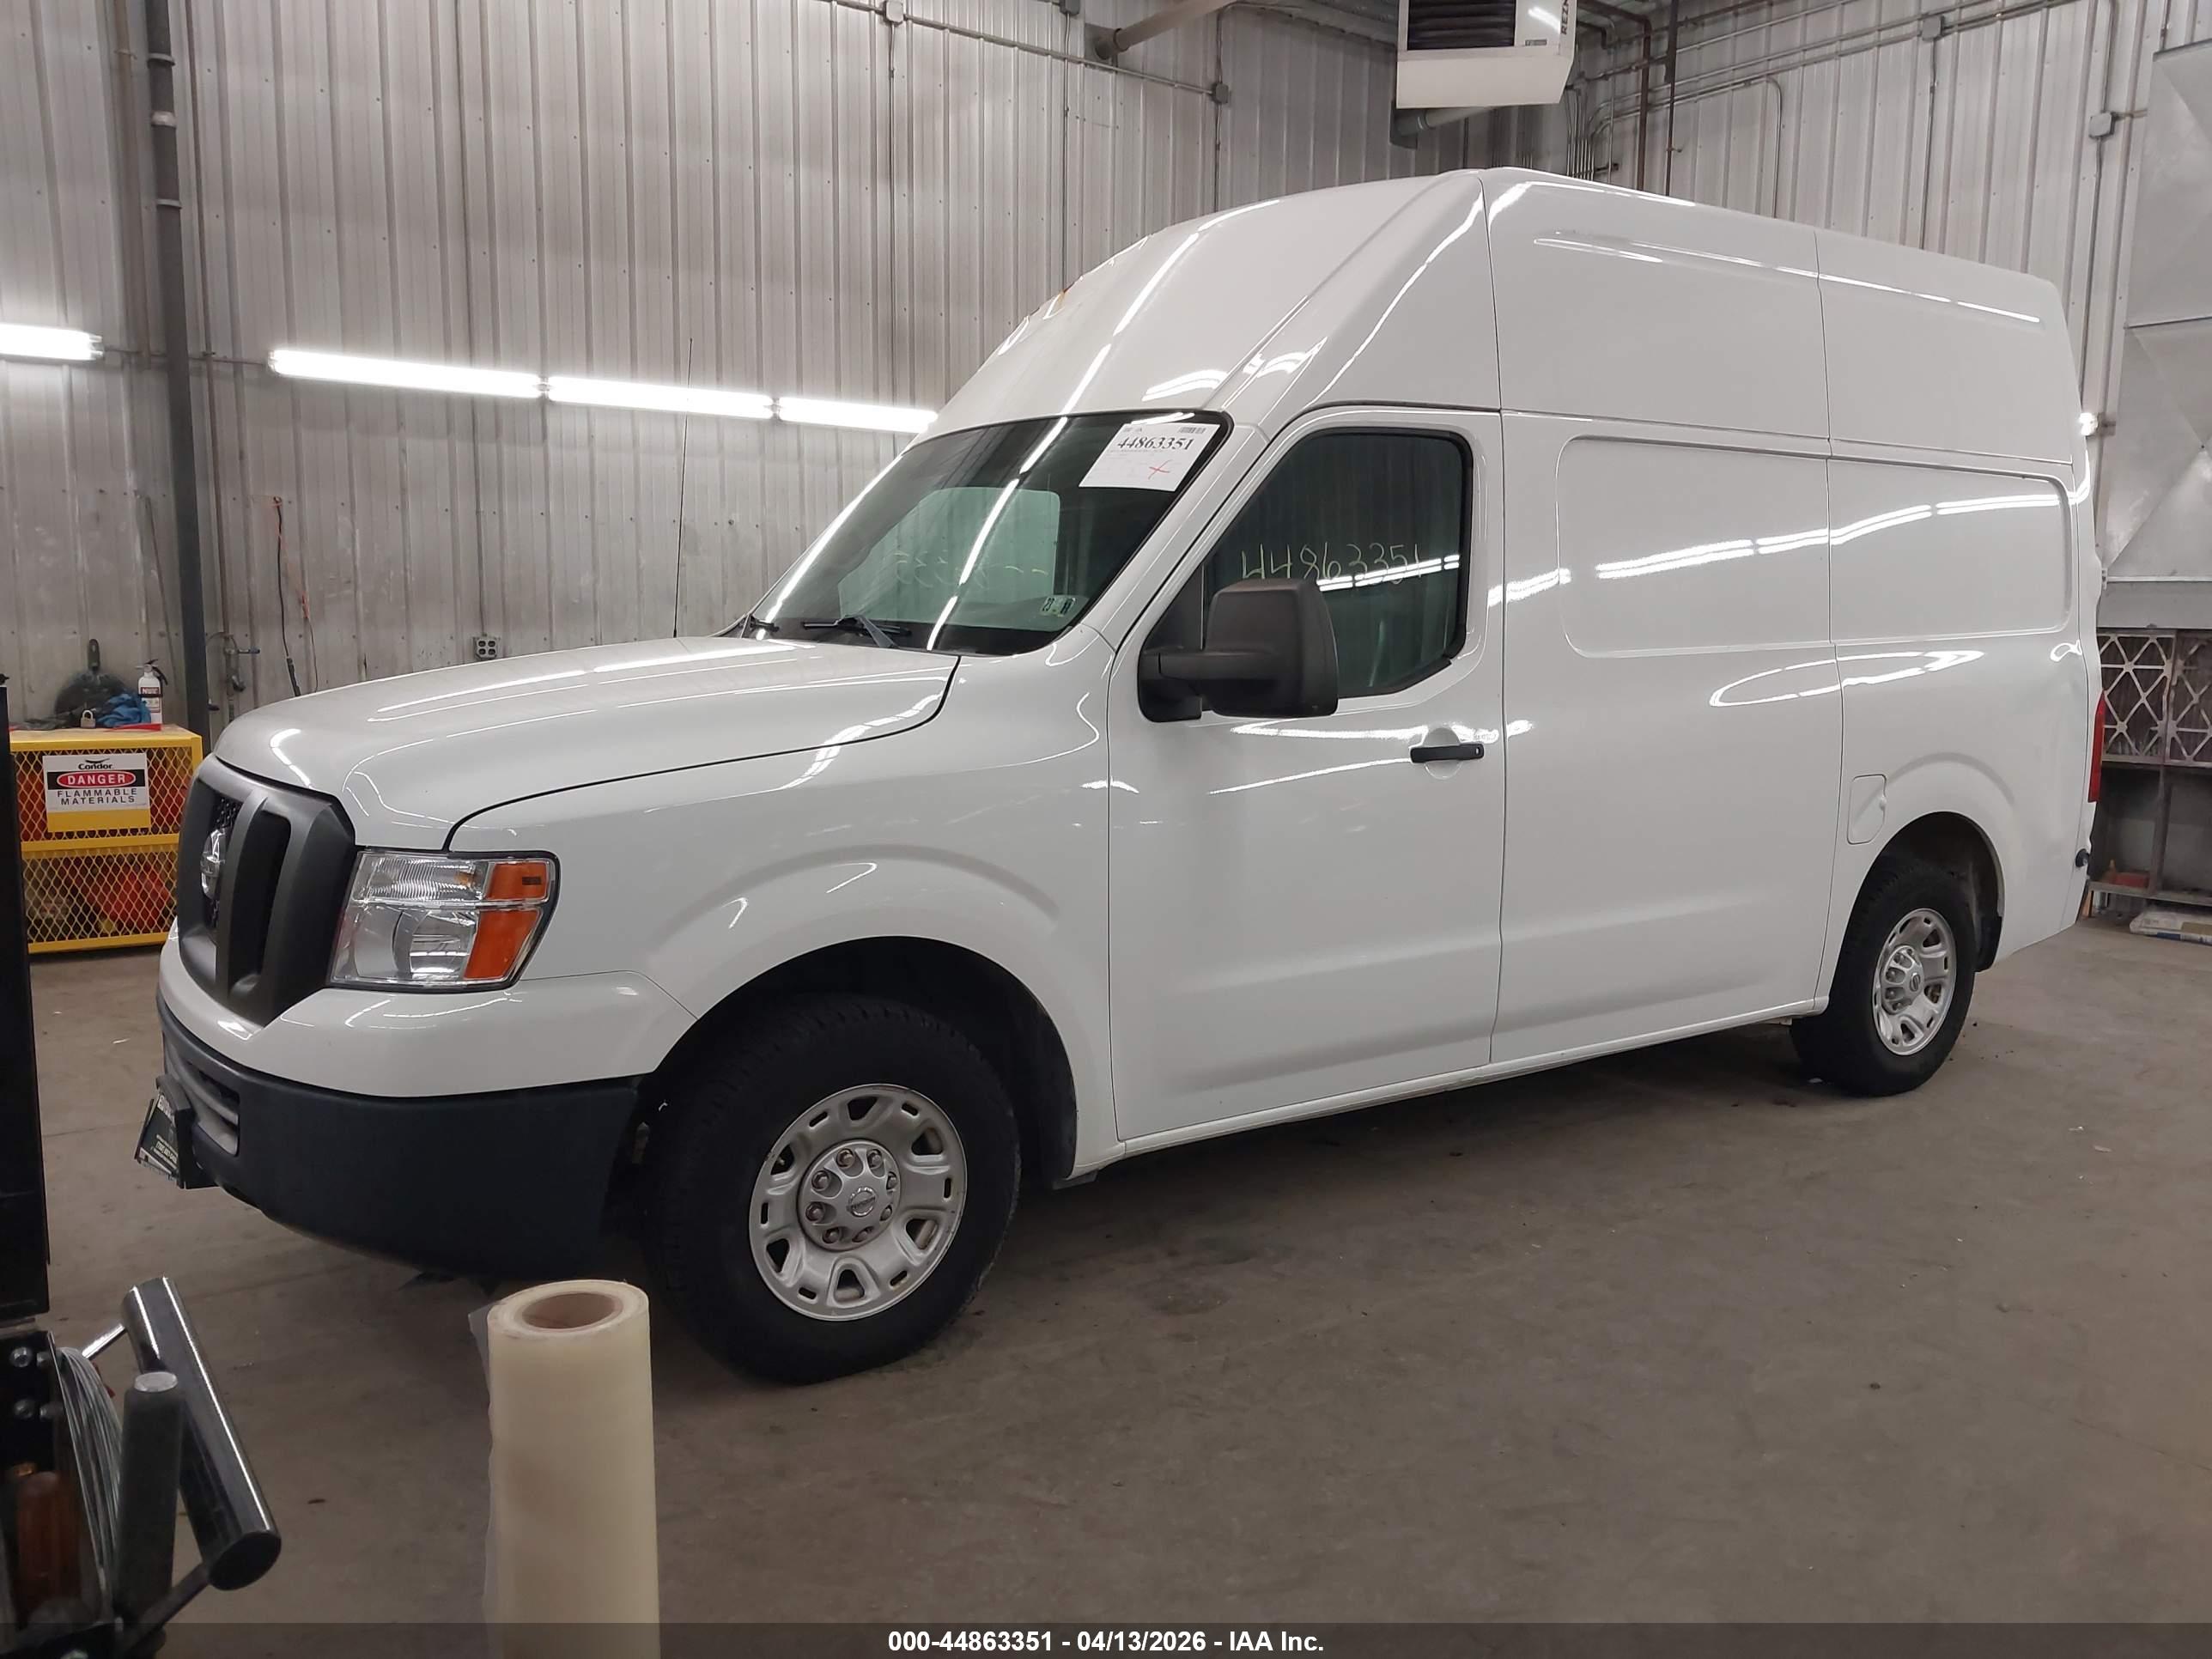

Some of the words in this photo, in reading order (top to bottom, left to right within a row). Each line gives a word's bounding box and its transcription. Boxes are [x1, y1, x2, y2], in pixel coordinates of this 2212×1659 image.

[1117, 436, 1195, 451] 44863351
[1242, 542, 1421, 584] 44863351
[67, 775, 125, 785] DANGER
[57, 788, 137, 798] FLAMMABLE
[61, 796, 135, 805] MATERIALS
